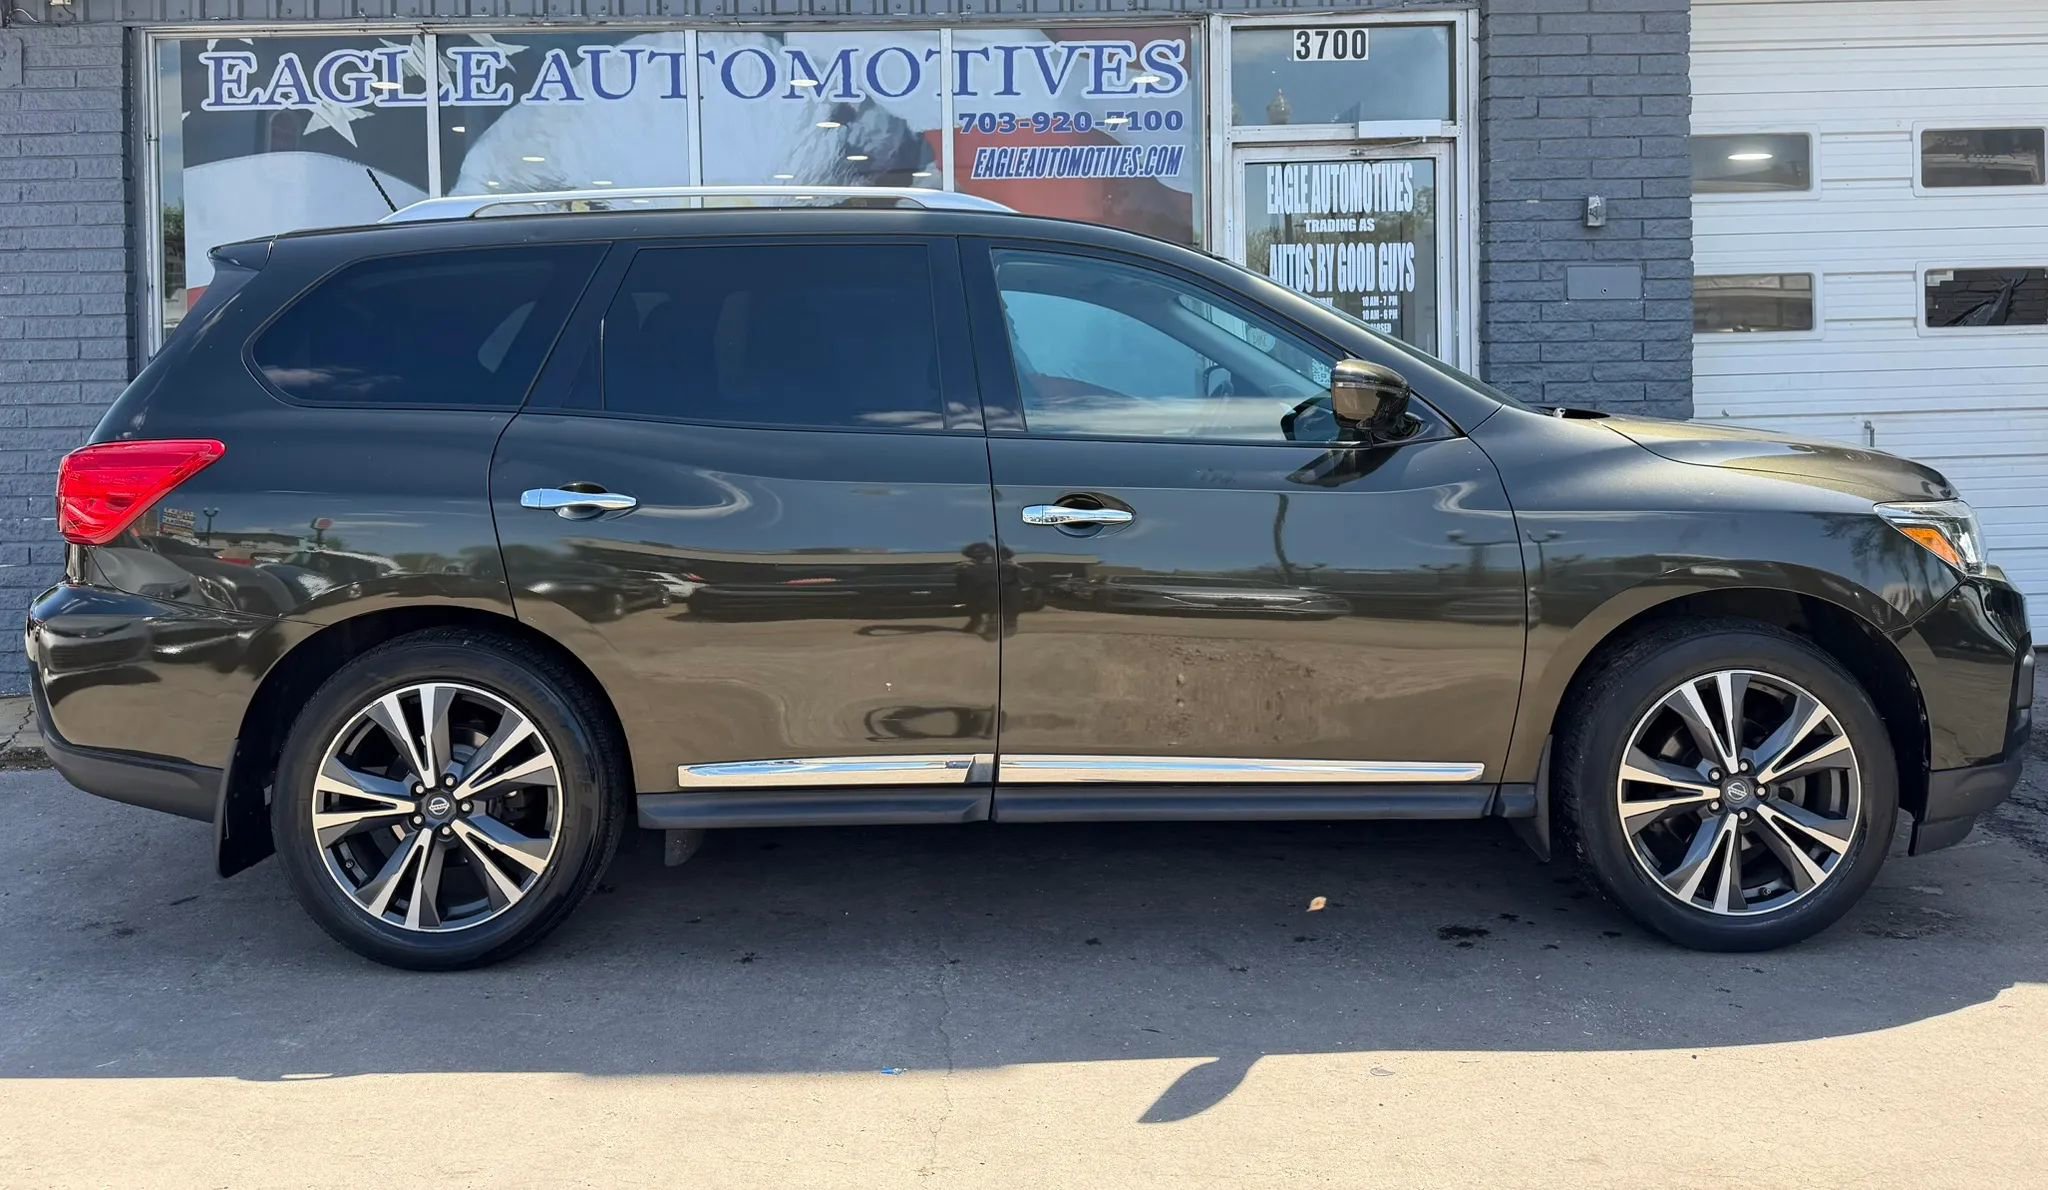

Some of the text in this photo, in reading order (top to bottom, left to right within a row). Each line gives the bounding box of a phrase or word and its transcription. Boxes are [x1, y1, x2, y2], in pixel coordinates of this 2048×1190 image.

[1296, 30, 1366, 59] 3700
[201, 40, 1188, 110] EAGLE AUTOMOTIVES
[958, 111, 1183, 133] 703-920-7100
[971, 145, 1184, 179] EAGLEAUTOMOTIVES.COM
[1267, 162, 1413, 214] EAGLE AUTOMOTIVES
[1304, 218, 1375, 232] TRADING AS
[1269, 242, 1415, 293] AUTOS BY GOOD GUYS
[1362, 296, 1369, 306] 10
[1370, 296, 1379, 306] AM
[1388, 295, 1398, 306] PM
[1362, 310, 1369, 320] 10
[1370, 309, 1379, 320] AM
[1389, 309, 1398, 319] PM
[1370, 323, 1391, 333] OSED
